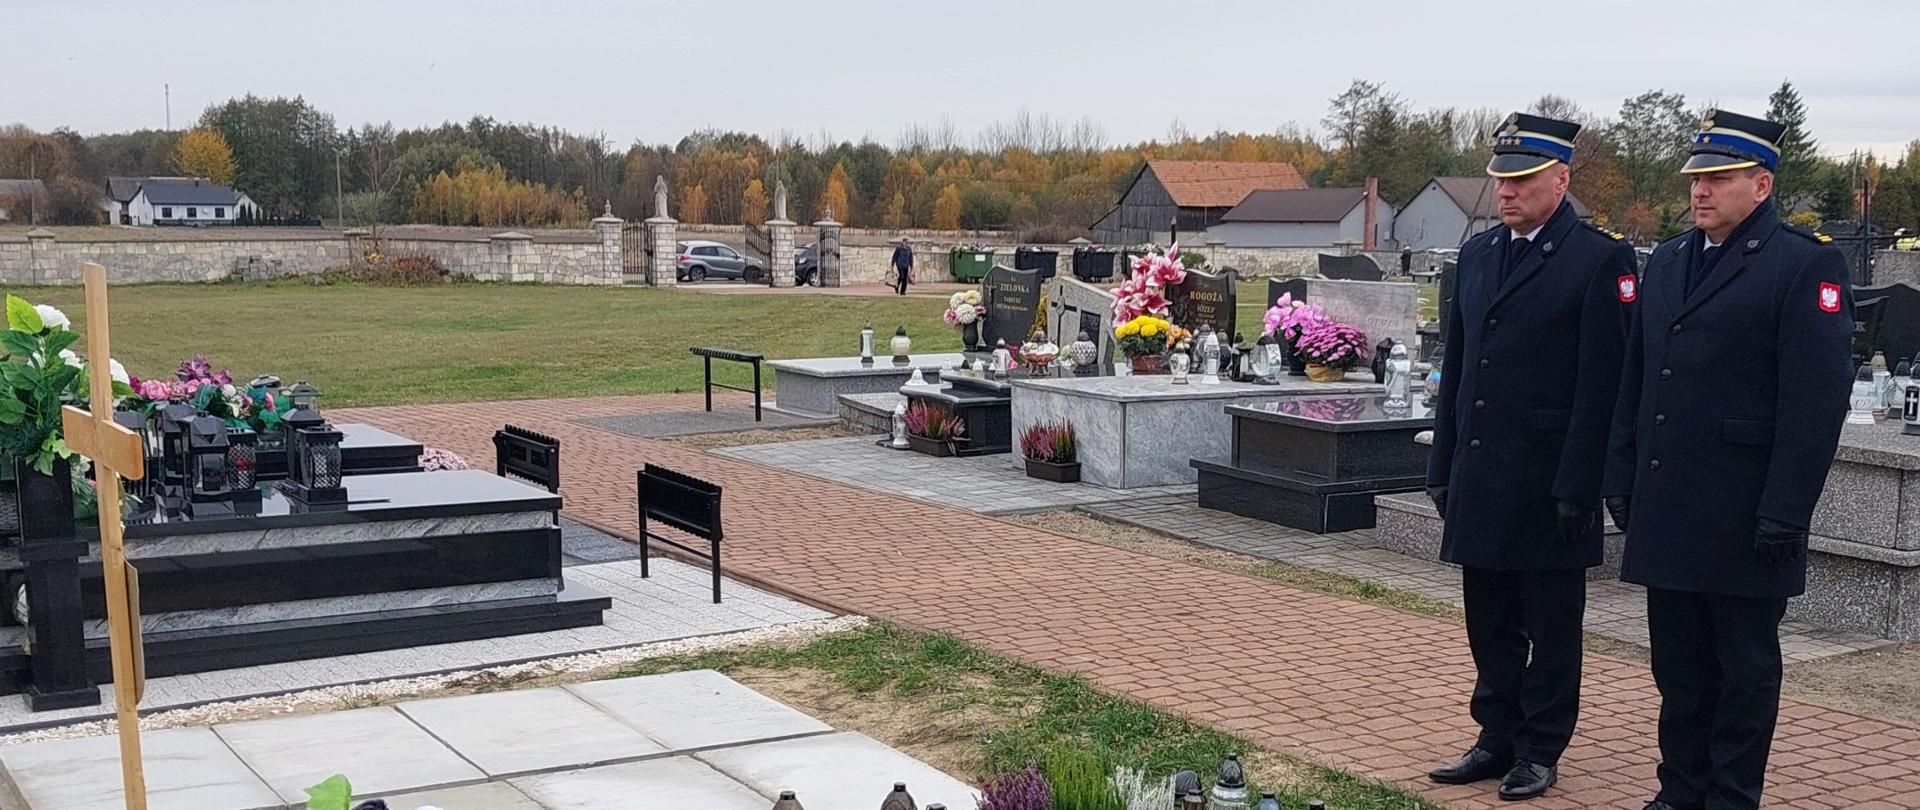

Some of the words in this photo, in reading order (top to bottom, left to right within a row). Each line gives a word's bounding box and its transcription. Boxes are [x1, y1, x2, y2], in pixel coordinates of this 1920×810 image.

[1000, 283, 1030, 293] ZIELONKA
[1190, 290, 1223, 302] ROGOŻA
[1197, 303, 1216, 313] JÓZEF
